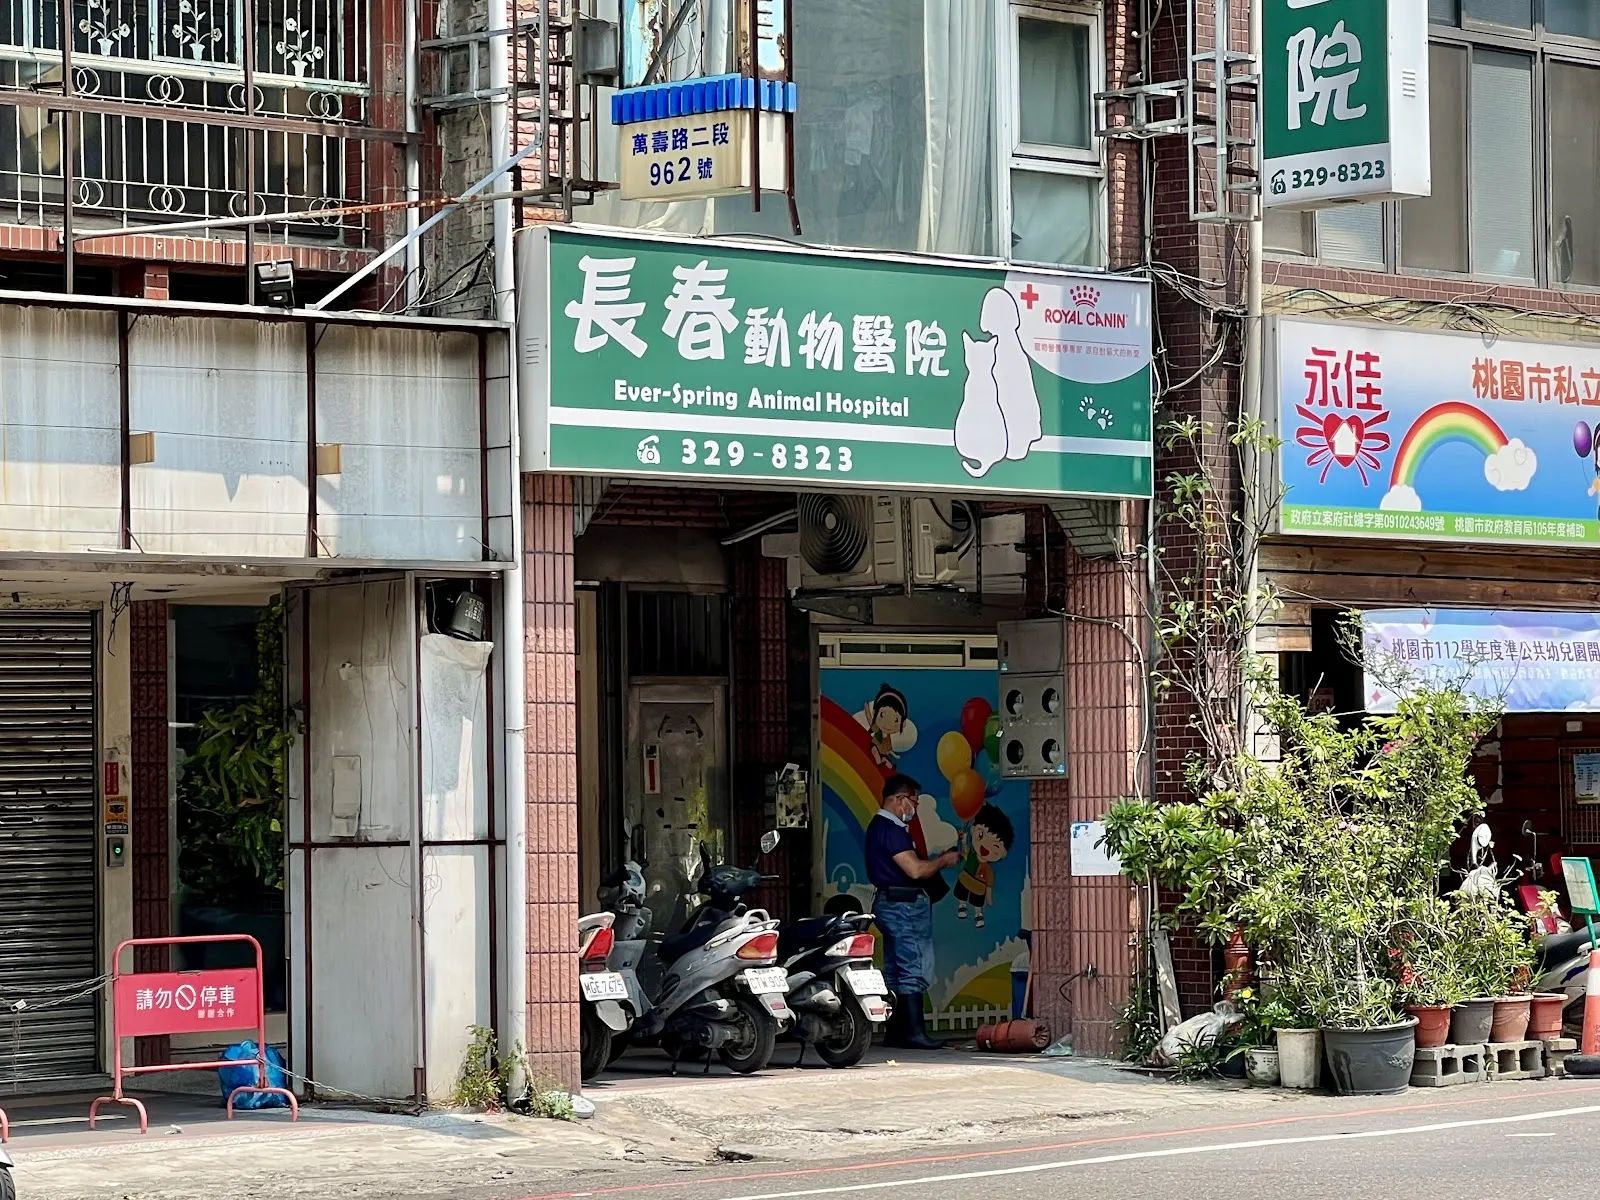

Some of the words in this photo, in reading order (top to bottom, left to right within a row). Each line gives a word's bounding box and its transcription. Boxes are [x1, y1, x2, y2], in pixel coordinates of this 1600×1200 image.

[1286, 0, 1367, 131] 院
[632, 122, 729, 156] 萬壽路二段
[650, 156, 713, 186] 962號
[1292, 160, 1385, 189] 329-8323
[564, 255, 950, 377] 長春動物醫院
[1044, 308, 1083, 325] ROYAL
[1086, 311, 1126, 328] CANIN
[1304, 346, 1383, 411] 永佳
[1471, 356, 1600, 406] 桃園市私立
[614, 379, 738, 411] Ever-Spring
[747, 387, 821, 412] Animal
[826, 392, 909, 419] Hospital
[681, 438, 853, 472] 329-8323
